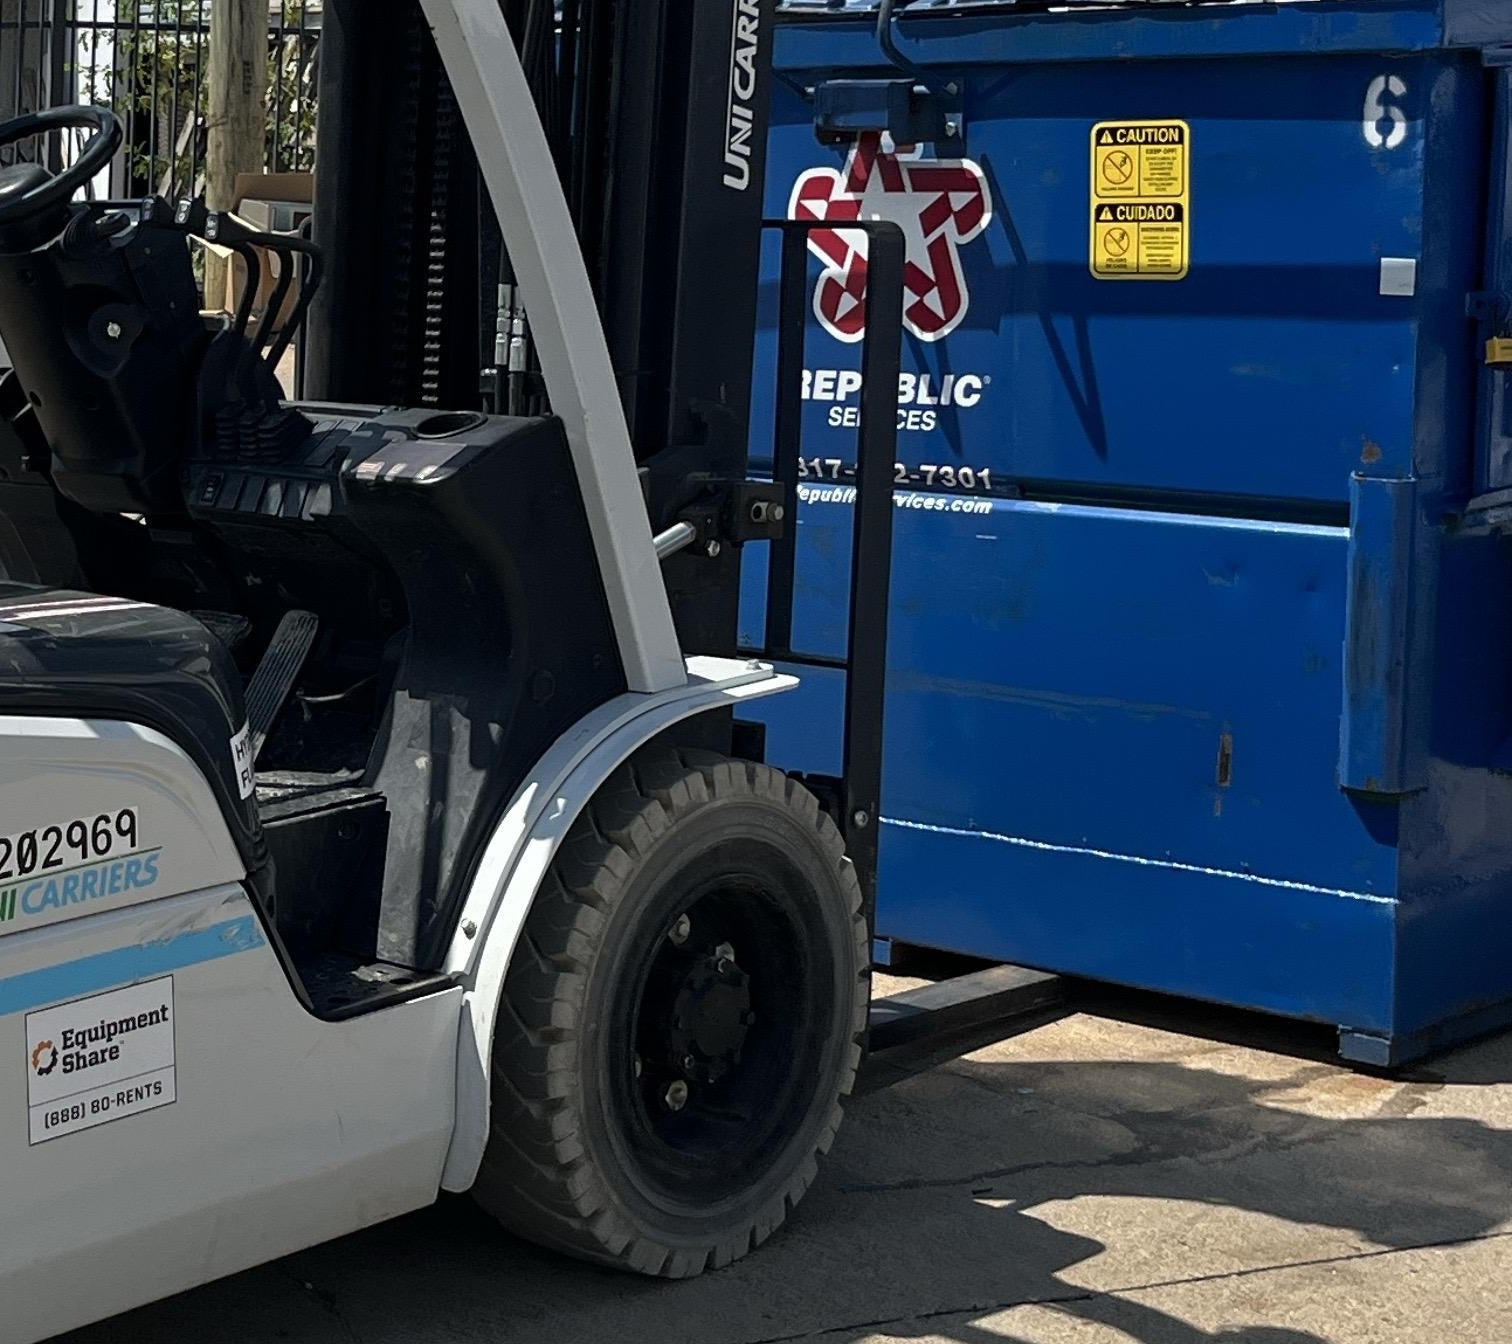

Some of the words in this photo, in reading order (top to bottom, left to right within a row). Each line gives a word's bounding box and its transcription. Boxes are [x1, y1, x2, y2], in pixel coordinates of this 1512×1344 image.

[1362, 73, 1408, 151] 6
[1115, 128, 1180, 144] CAUTION
[1115, 205, 1176, 222] CUIDADO
[61, 1004, 170, 1051] Equipment
[61, 1044, 121, 1074] Share
[44, 1101, 87, 1130] (888)
[90, 1080, 164, 1115] 80-RENTS
